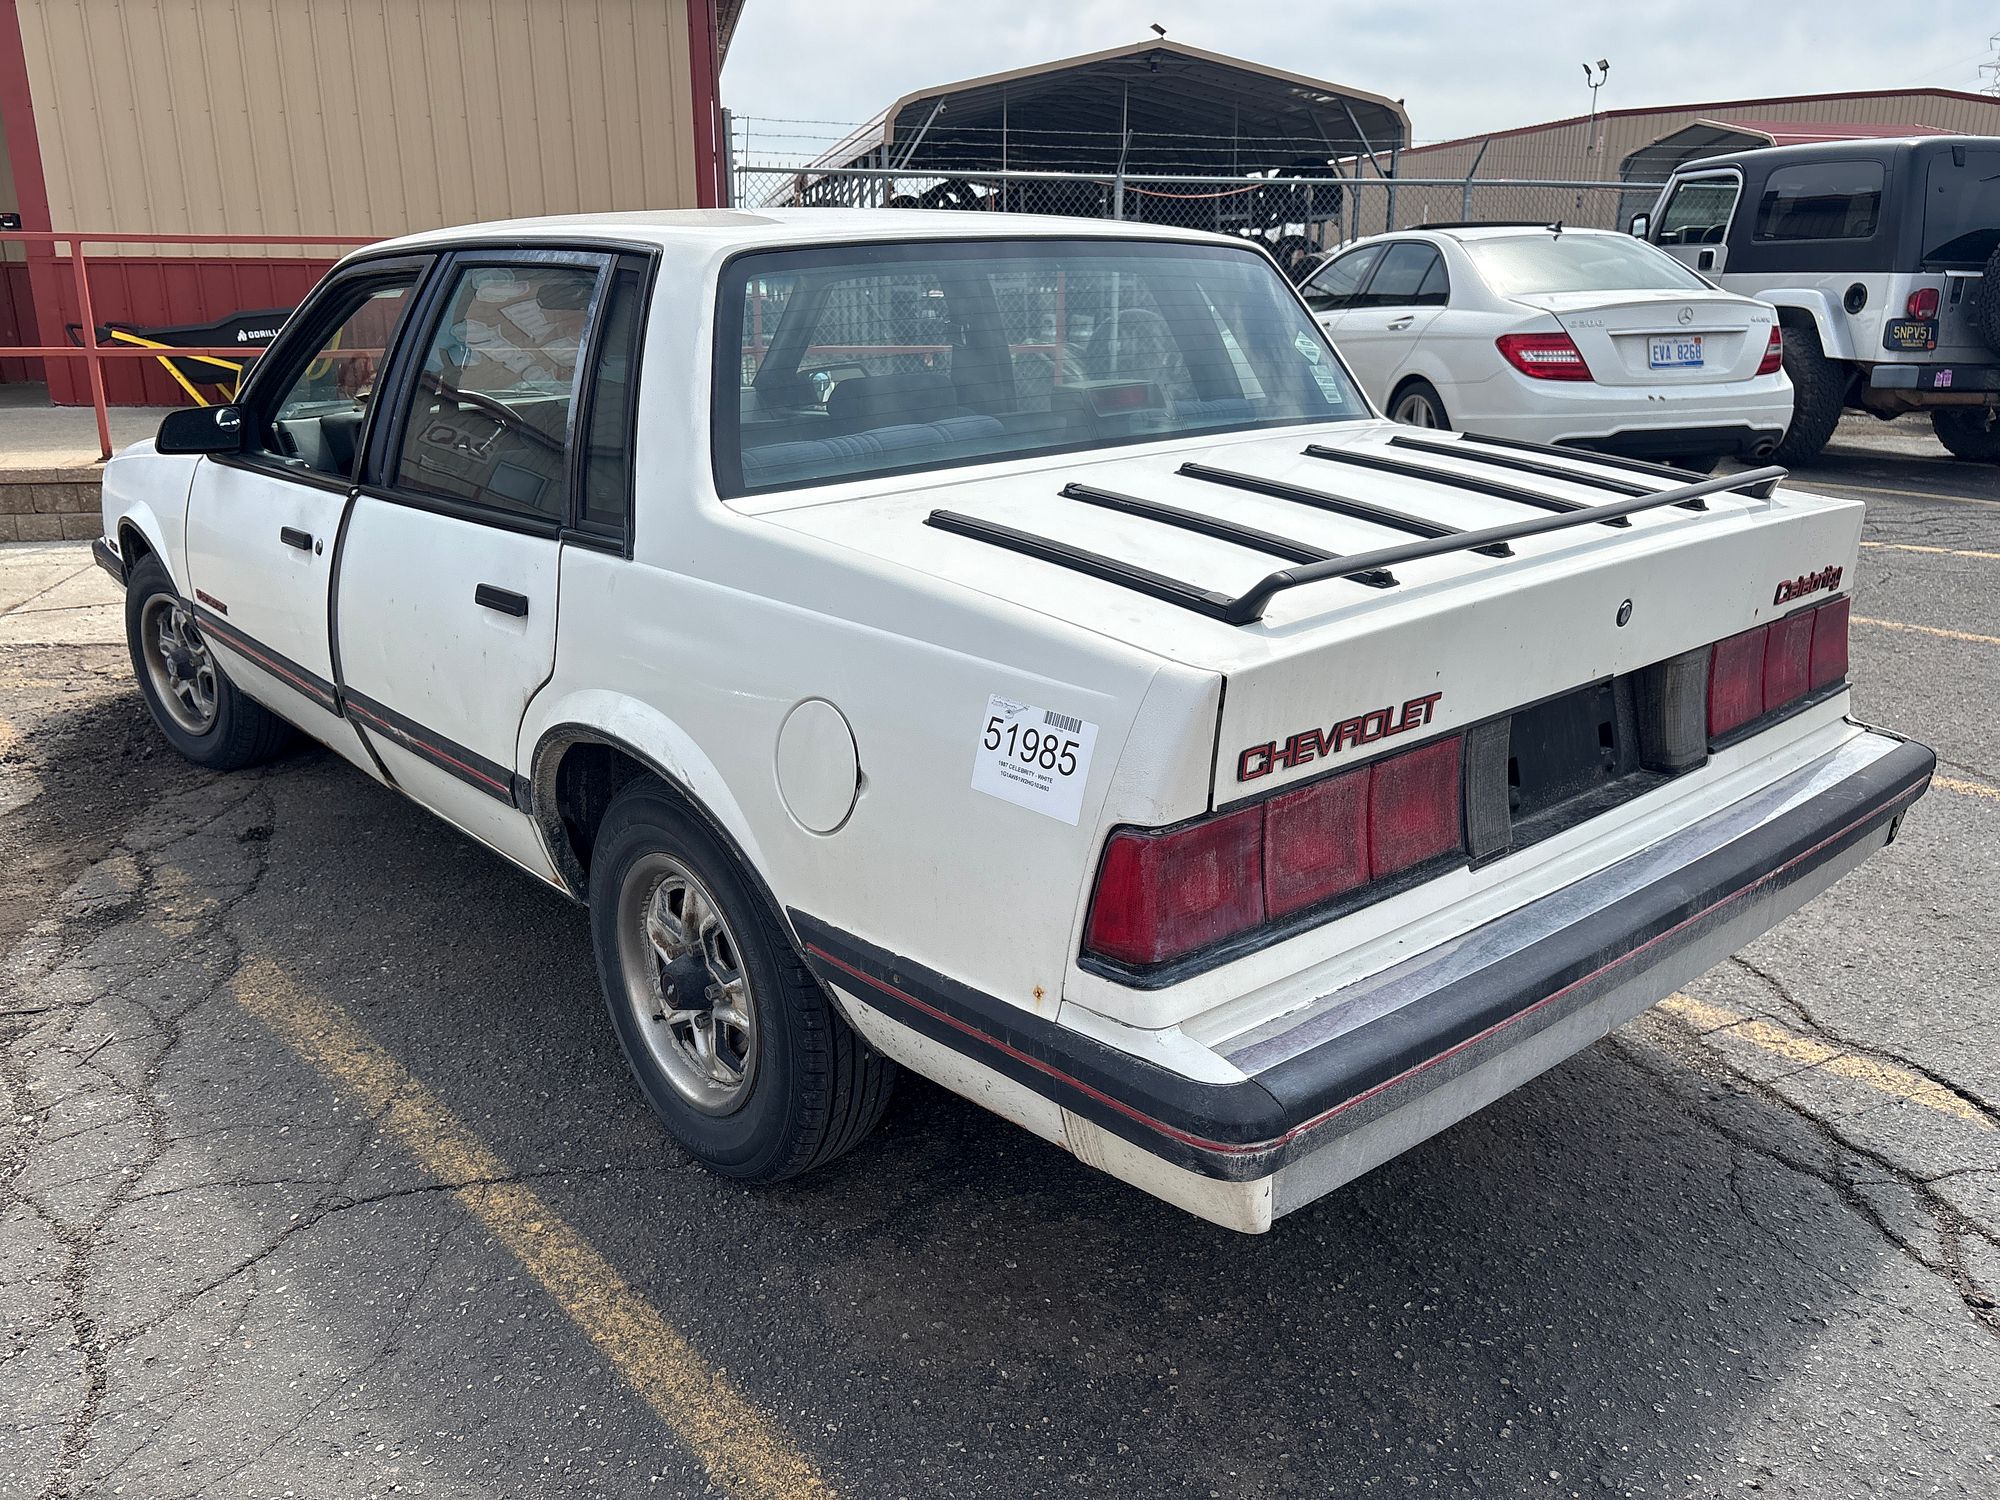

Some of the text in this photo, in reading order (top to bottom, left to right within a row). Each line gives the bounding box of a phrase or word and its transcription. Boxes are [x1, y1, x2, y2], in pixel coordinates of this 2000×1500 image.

[247, 328, 281, 339] GORILL
[1893, 325, 1932, 340] 5NPV51
[1653, 343, 1702, 361] EVA 8268
[1773, 564, 1844, 606] Celebrity
[983, 716, 1080, 777] 51985
[1237, 691, 1443, 783] CHEVROLET
[998, 760, 1009, 768] 1987
[1008, 763, 1036, 777] CELEBRITY
[1037, 773, 1054, 784] WHITE
